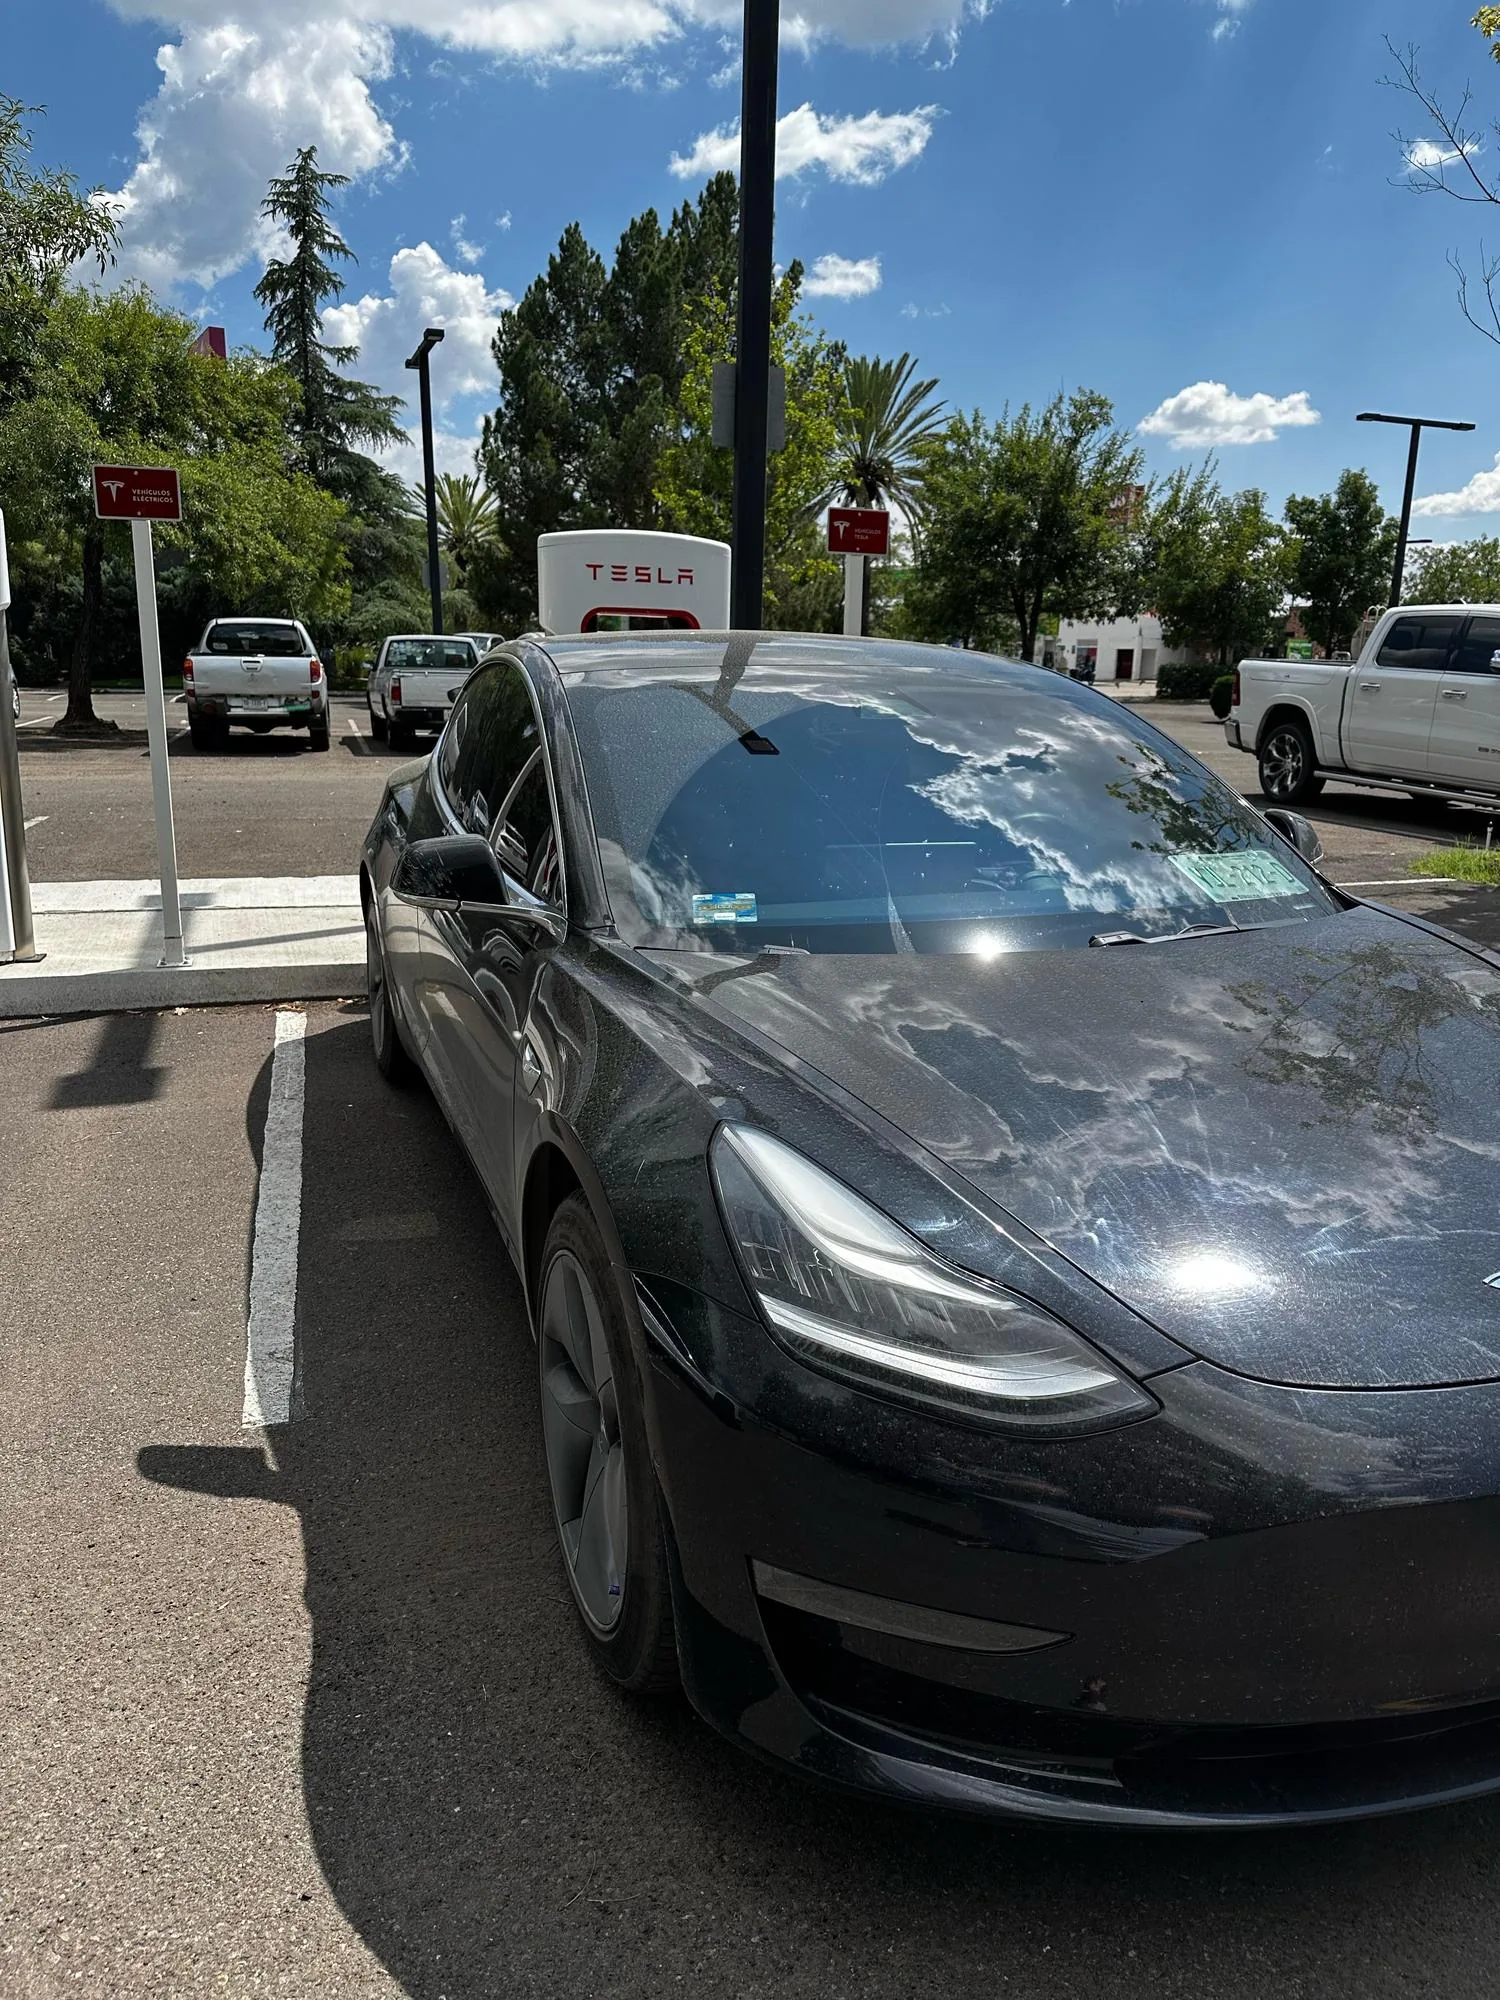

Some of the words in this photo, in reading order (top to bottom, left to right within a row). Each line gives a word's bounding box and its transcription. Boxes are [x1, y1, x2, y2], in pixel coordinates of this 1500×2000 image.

[132, 488, 170, 496] VEHÍCULOS
[132, 495, 174, 503] ELÉCTRICOS
[585, 563, 694, 585] TESLA
